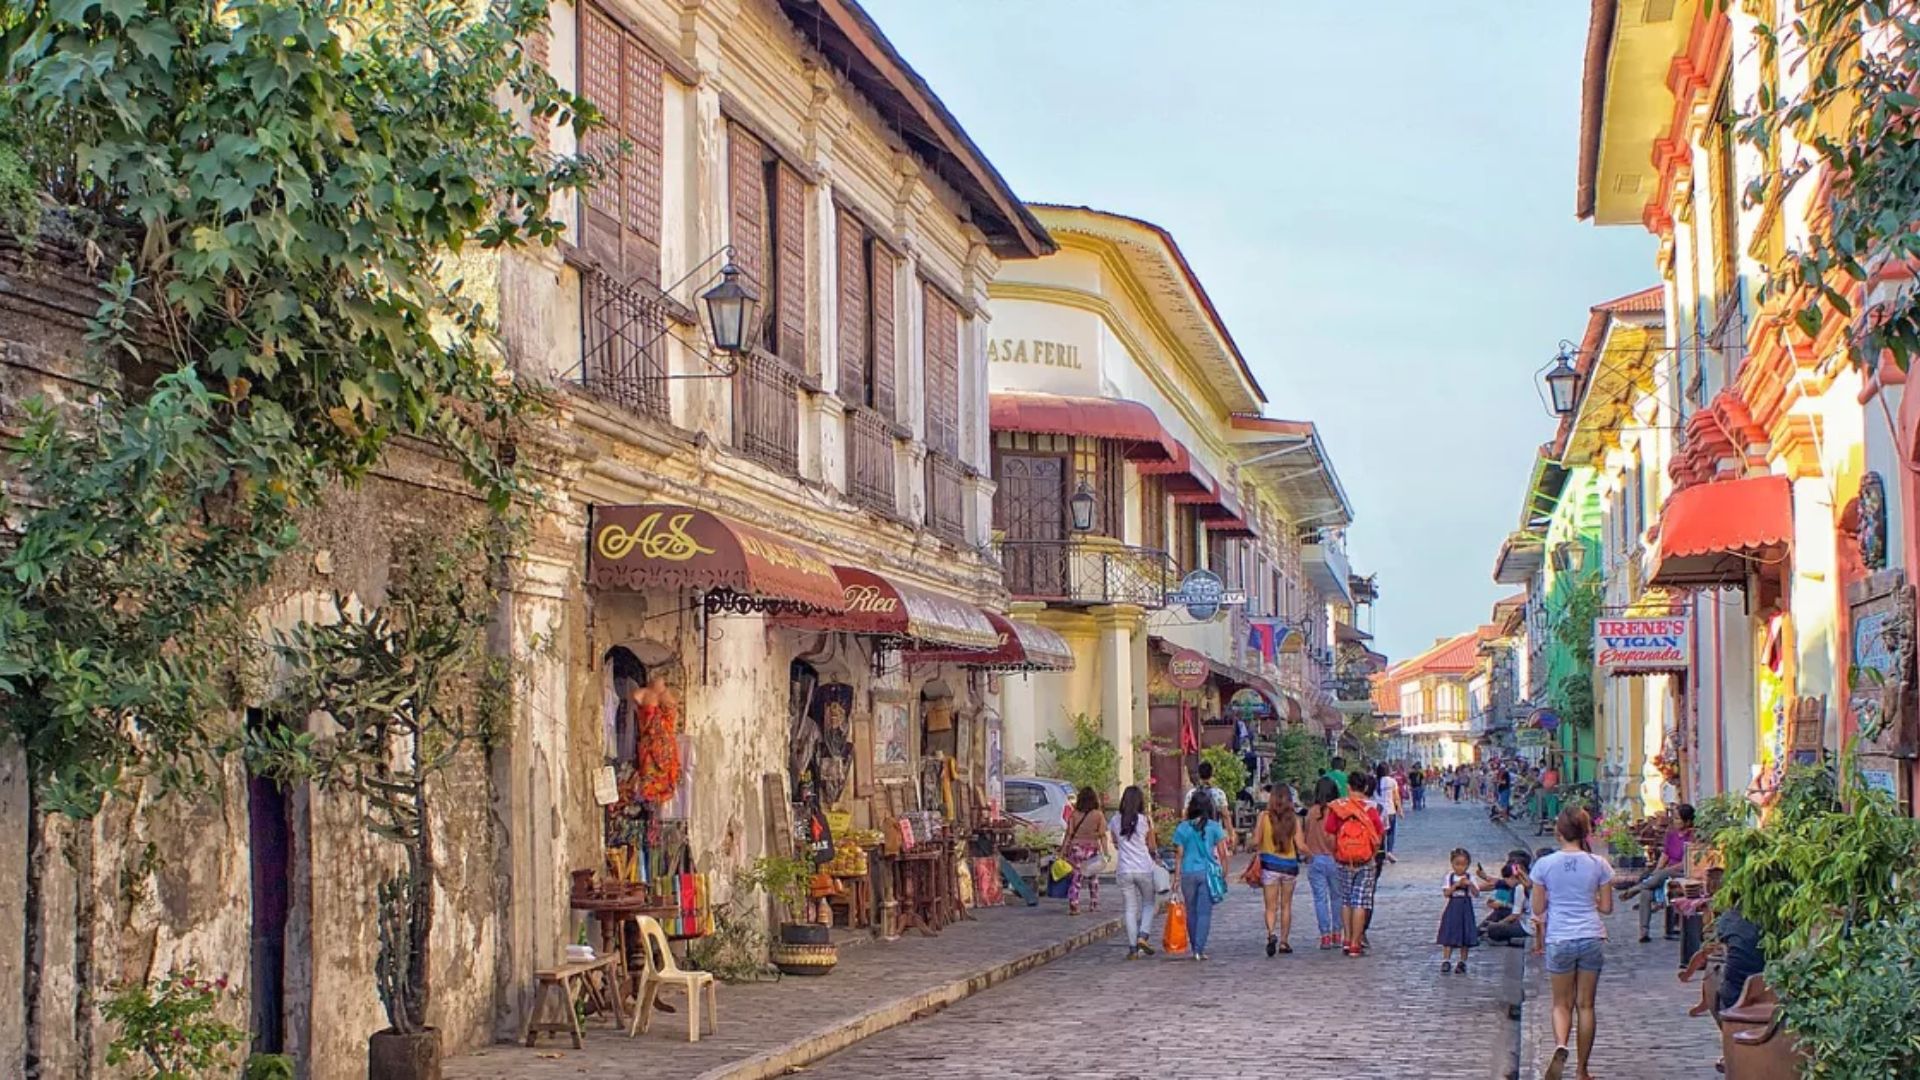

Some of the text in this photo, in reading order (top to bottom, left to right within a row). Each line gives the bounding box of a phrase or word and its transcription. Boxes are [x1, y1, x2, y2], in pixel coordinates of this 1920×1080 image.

[987, 339, 1082, 369] ASA FERIL
[843, 584, 898, 612] Rica
[1599, 620, 1684, 636] IRENE'S
[1603, 636, 1677, 648] VIGAN
[1598, 646, 1683, 665] Empanada
